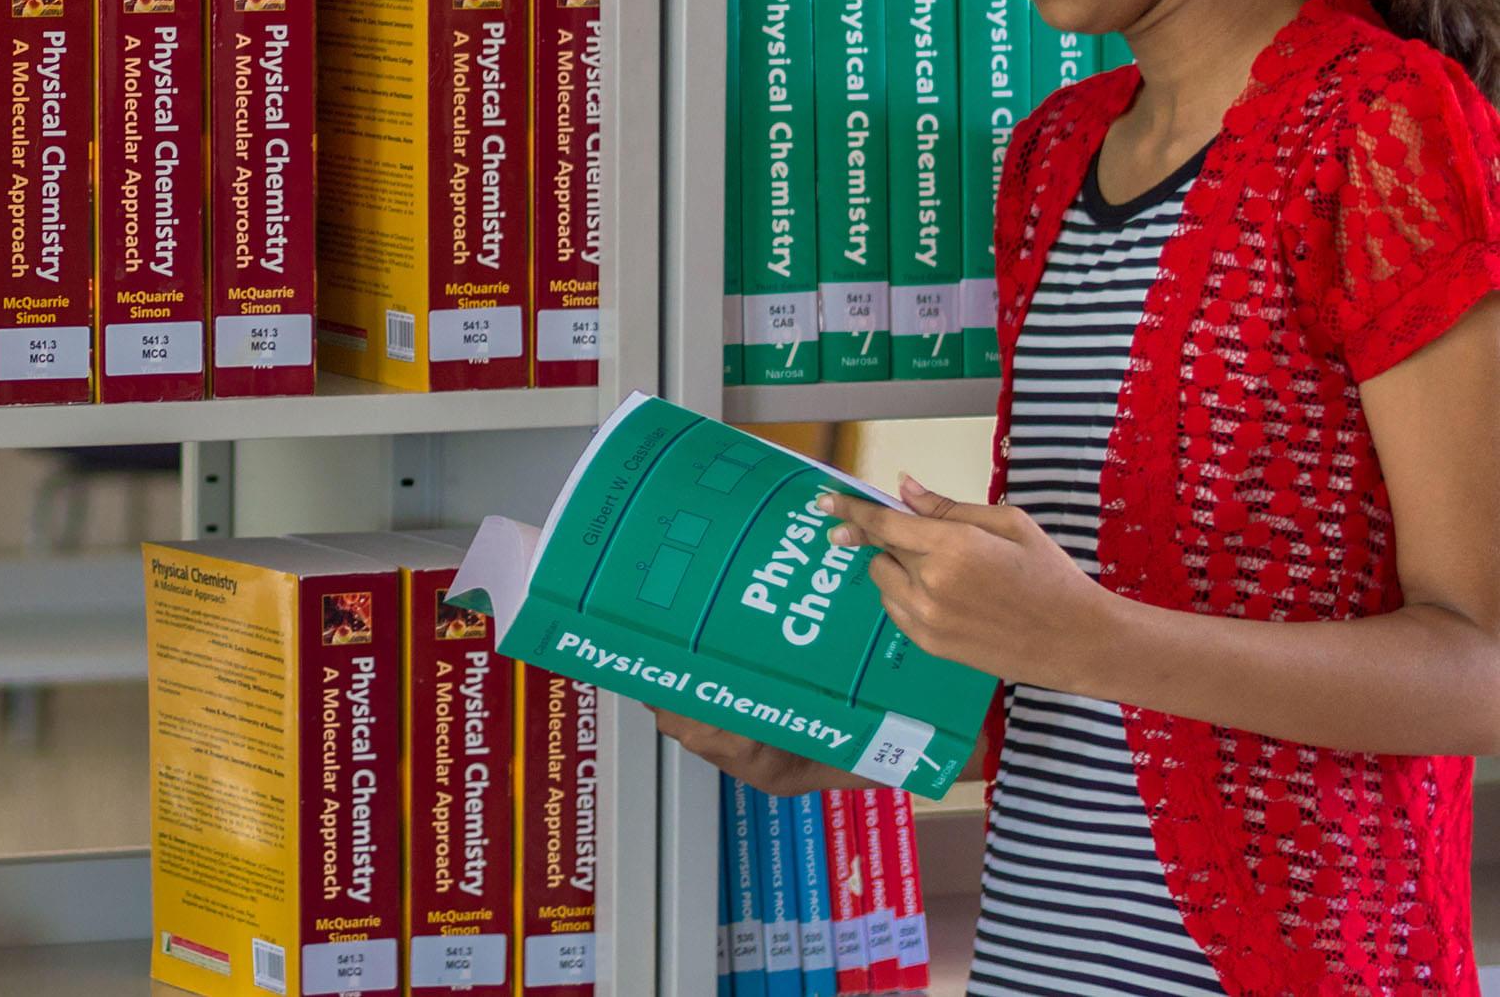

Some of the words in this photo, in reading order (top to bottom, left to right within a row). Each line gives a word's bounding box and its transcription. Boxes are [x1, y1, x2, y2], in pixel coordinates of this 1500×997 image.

[235, 33, 252, 50] A
[259, 25, 290, 129] Physical
[453, 30, 470, 47] A
[476, 22, 506, 126] Physical
[235, 55, 253, 160] Molecular
[453, 53, 471, 157] Molecular
[231, 166, 254, 269] Approach
[260, 138, 290, 273] Chemistry
[449, 162, 471, 265] Approach
[477, 135, 506, 269] Chemistry
[767, 122, 796, 278] Chemistry
[843, 110, 872, 266] Chemistry
[913, 113, 941, 268] Chemistry
[228, 286, 294, 300] McQuarrie
[241, 303, 281, 314] Simon
[251, 329, 278, 337] 541.3
[769, 305, 795, 315] 541.3
[773, 318, 794, 328] CAS
[251, 342, 276, 351] MCQ
[766, 369, 804, 379] Narosa
[841, 356, 878, 366] Narosa
[582, 494, 619, 546] Gilbert
[611, 476, 632, 492] W.
[623, 426, 669, 472] Castellan
[152, 559, 188, 580] Physical
[191, 567, 237, 595] Chemistry
[323, 667, 339, 683] A
[346, 657, 377, 761] Physical
[459, 651, 489, 755] Physical
[556, 632, 691, 692] Physical
[695, 682, 853, 749] Chemistry
[323, 688, 341, 792] Molecular
[888, 747, 905, 765] CAS
[319, 798, 341, 900] Approach
[347, 769, 377, 903] Chemistry
[459, 763, 489, 896] Chemistry
[316, 915, 381, 930] McQuarrie
